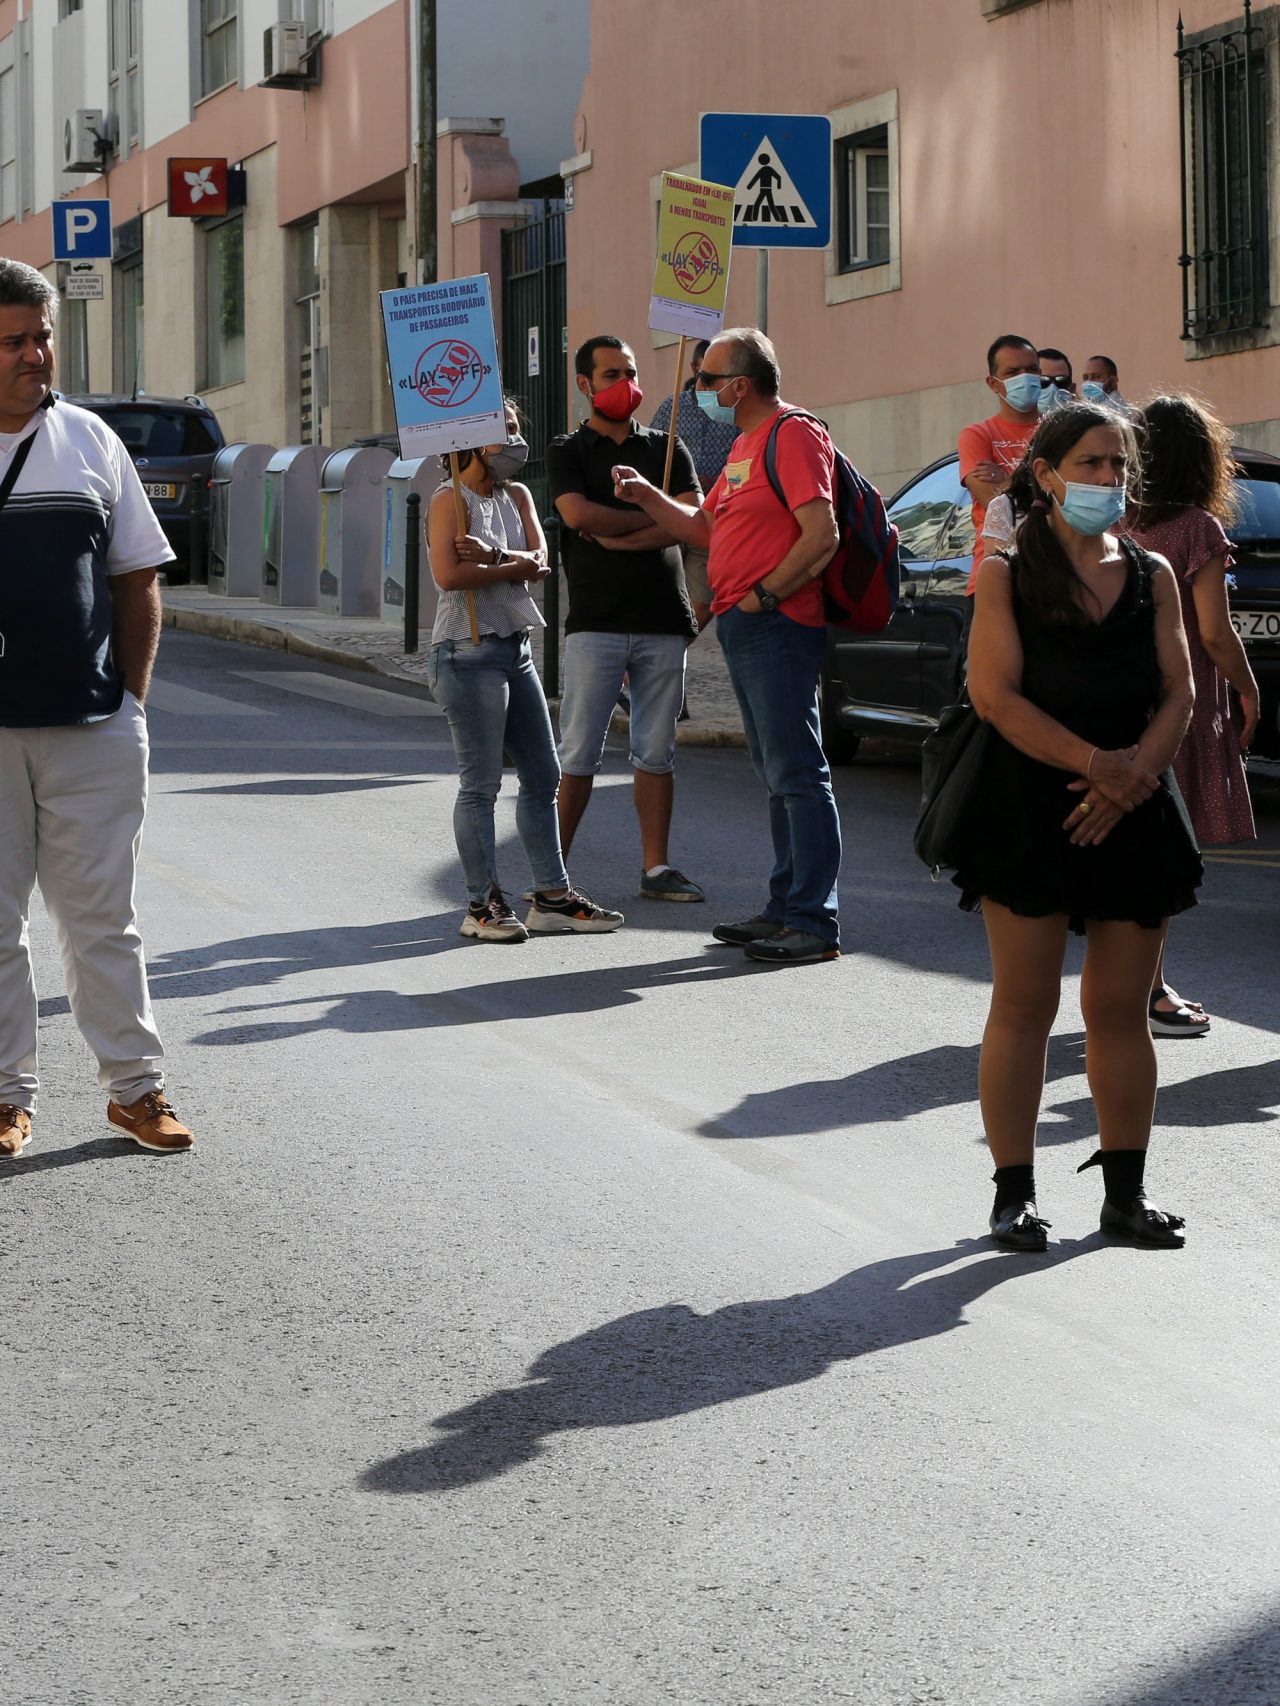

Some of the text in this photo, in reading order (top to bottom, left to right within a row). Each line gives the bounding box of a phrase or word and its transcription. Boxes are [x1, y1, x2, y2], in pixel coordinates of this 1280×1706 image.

[666, 177, 702, 195] TRABALHADOR
[703, 186, 710, 196] EM
[674, 205, 692, 218] MENOS
[692, 210, 726, 227] TRANSPORTES
[65, 208, 97, 251] P
[393, 283, 479, 307] O PAÍS PRECISA DE MAIS
[389, 296, 486, 322] TRANSPORTES RODOVIÁRIO
[409, 314, 469, 333] DE PASSAGEIROS
